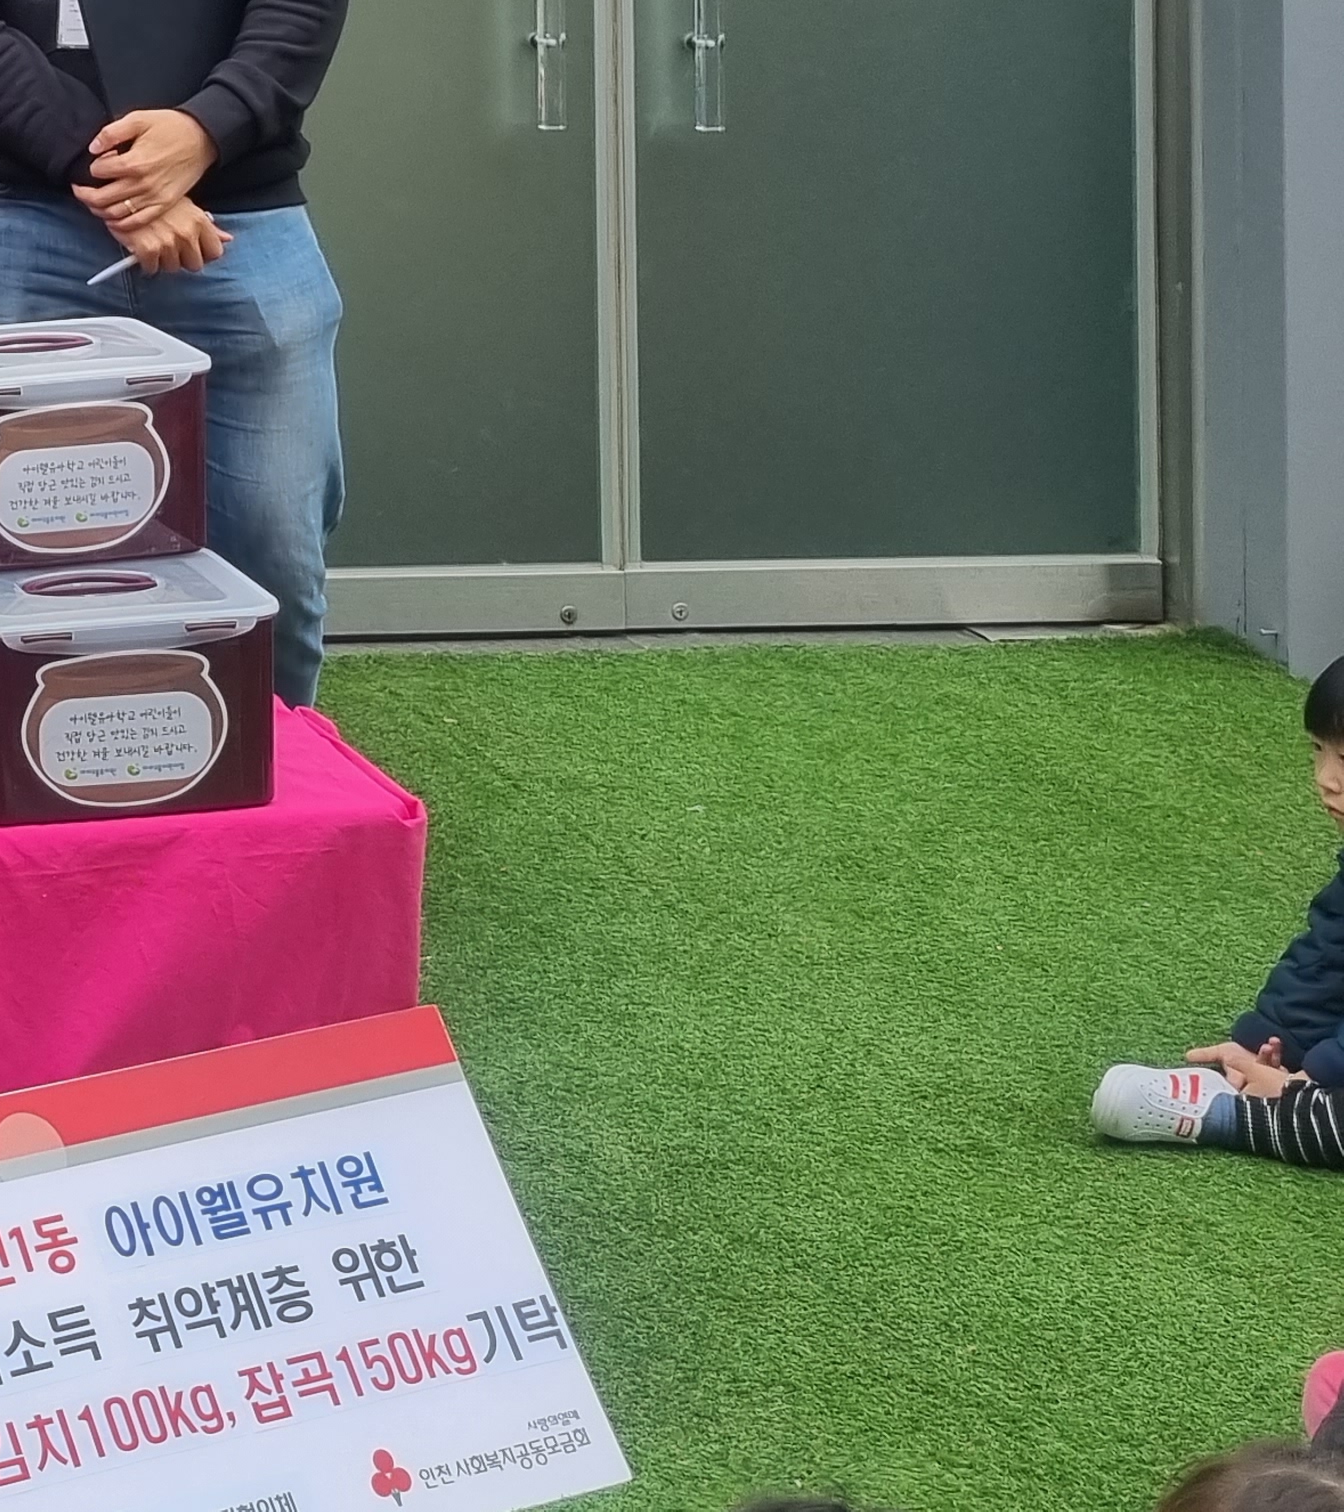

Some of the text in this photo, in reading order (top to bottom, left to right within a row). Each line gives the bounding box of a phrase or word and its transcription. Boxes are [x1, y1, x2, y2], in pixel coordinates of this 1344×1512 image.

[140, 706, 181, 719] 어린이들이
[56, 742, 197, 762] 건강한 겨울 보내시길 바랍니다.
[64, 732, 81, 744] 직접
[111, 727, 137, 740] 맛있는
[142, 726, 158, 737] 김치
[162, 724, 187, 735] 드시고
[104, 1151, 390, 1258] 아이웰유치원
[128, 1264, 313, 1354] 취약계층
[332, 1234, 426, 1303] 위한
[418, 1427, 592, 1490] 인천 사회복지공동모금회
